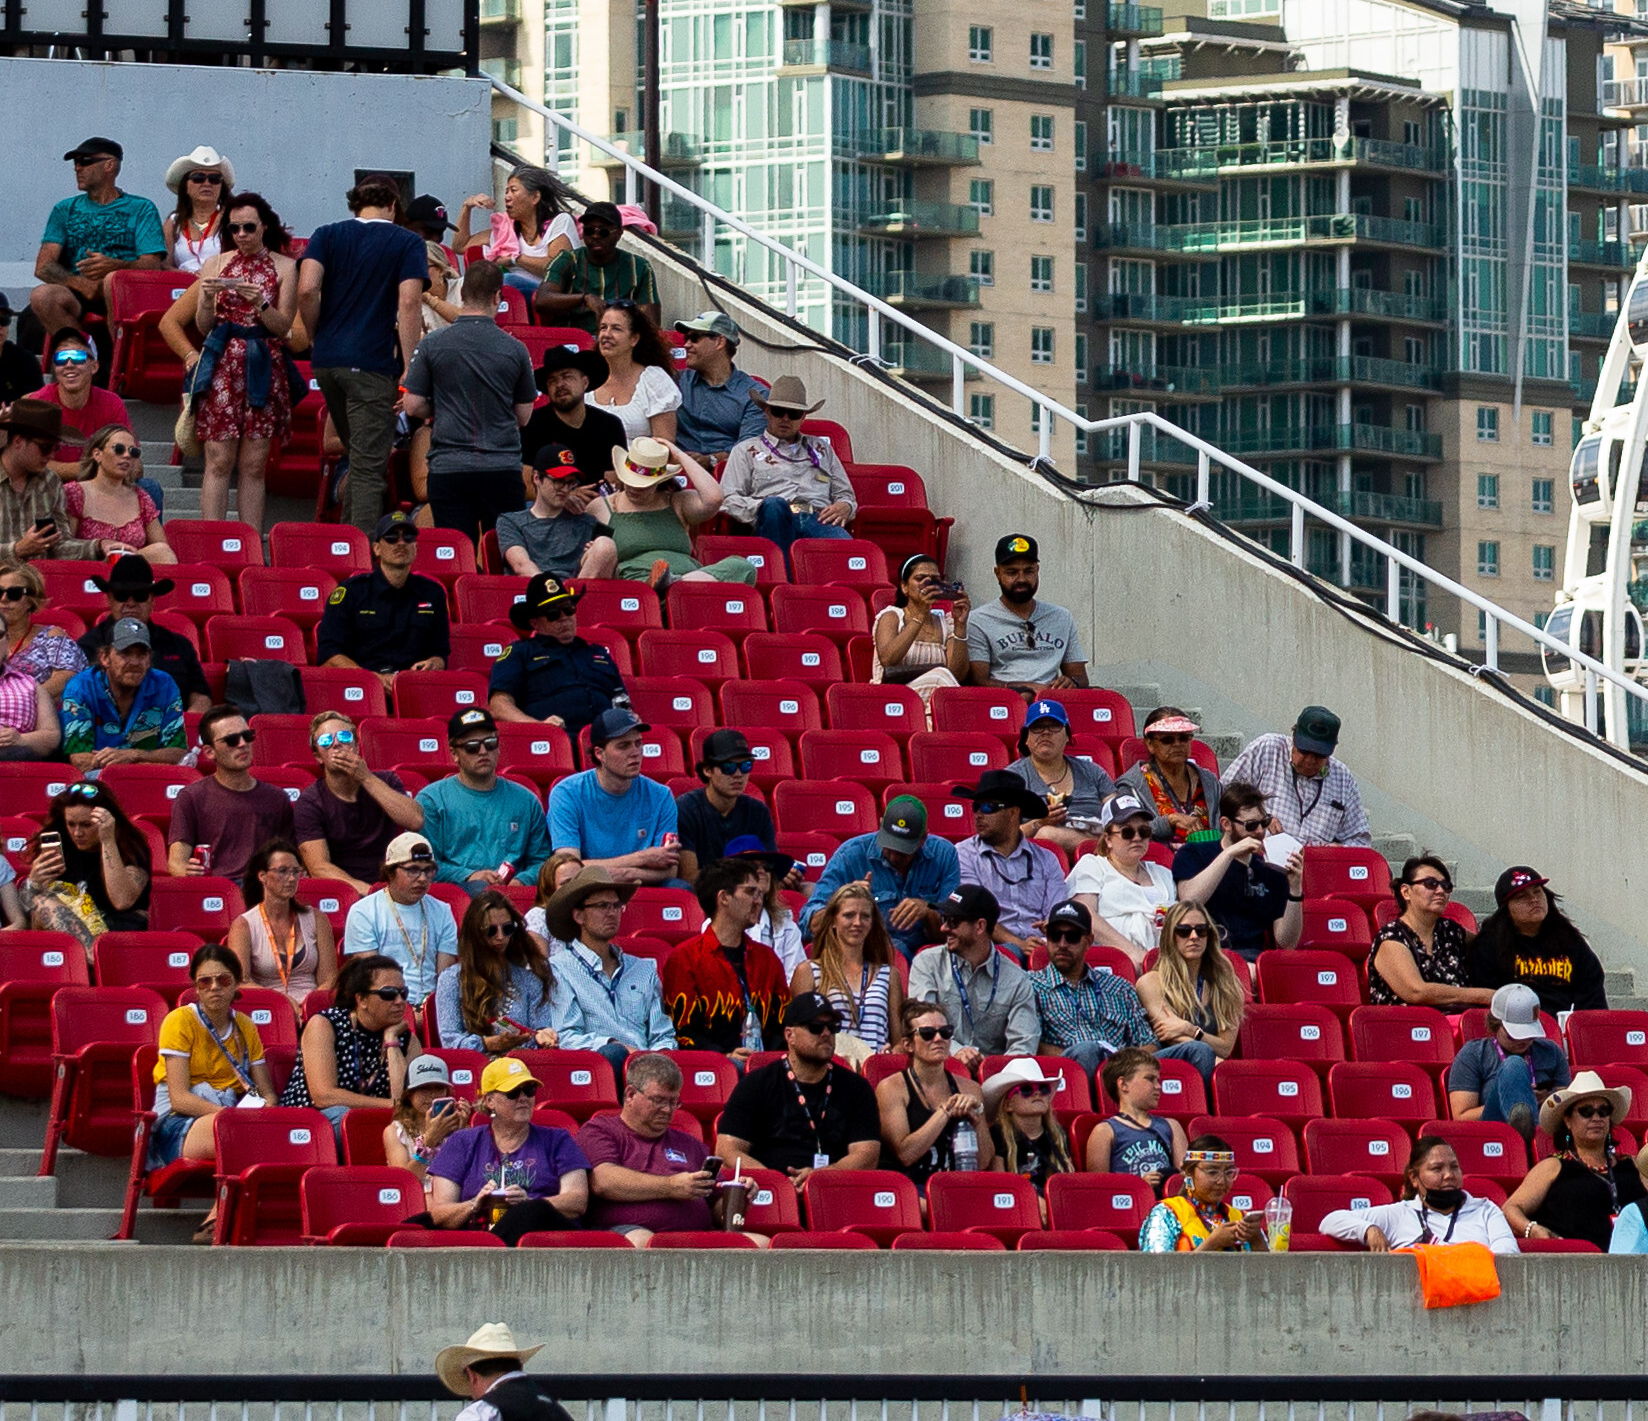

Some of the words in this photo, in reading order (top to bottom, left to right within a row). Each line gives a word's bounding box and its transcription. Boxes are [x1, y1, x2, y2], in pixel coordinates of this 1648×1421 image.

[890, 484, 903, 492] 201
[225, 541, 239, 549] 193
[334, 543, 349, 554] 194
[439, 548, 453, 557] 195
[851, 559, 865, 567] 199
[194, 585, 209, 594] 192
[623, 600, 637, 609] 196
[728, 602, 742, 611] 197
[831, 607, 845, 615] 198
[268, 637, 282, 646] 192
[997, 630, 1065, 650] BUFALO
[486, 646, 500, 654] 194
[700, 652, 715, 660] 196
[804, 654, 819, 664] 197
[347, 689, 362, 698] 192
[458, 693, 473, 701] 193
[674, 698, 691, 709] 195
[782, 702, 797, 711] 196
[886, 704, 902, 715] 197
[992, 708, 1007, 717] 198
[1095, 710, 1110, 719] 199
[422, 740, 437, 749] 192
[643, 745, 659, 756] 194
[863, 752, 878, 761] 196
[972, 754, 986, 763] 197
[838, 803, 853, 812] 195
[947, 806, 962, 815] 196
[809, 855, 824, 864] 194
[1351, 868, 1366, 877] 199
[322, 900, 338, 910] 189
[665, 909, 680, 918] 192
[1330, 920, 1345, 929] 198
[170, 954, 188, 966] 187
[1320, 973, 1335, 982] 197
[251, 1011, 270, 1023] 187
[1303, 1027, 1319, 1039] 196
[1414, 1029, 1429, 1039] 197
[1628, 1033, 1644, 1042] 199
[453, 1071, 471, 1082] 188
[572, 1073, 590, 1084] 189
[696, 1074, 714, 1085] 190
[1164, 1081, 1181, 1091] 194
[1281, 1084, 1296, 1094] 195
[1393, 1085, 1410, 1097] 196
[1254, 1141, 1272, 1152] 194
[1371, 1143, 1387, 1152] 195
[1486, 1144, 1501, 1154] 196
[875, 1193, 894, 1206] 190
[995, 1196, 1011, 1207] 191
[1113, 1197, 1131, 1208] 192
[1233, 1198, 1250, 1209] 193
[1353, 1200, 1369, 1209] 194
